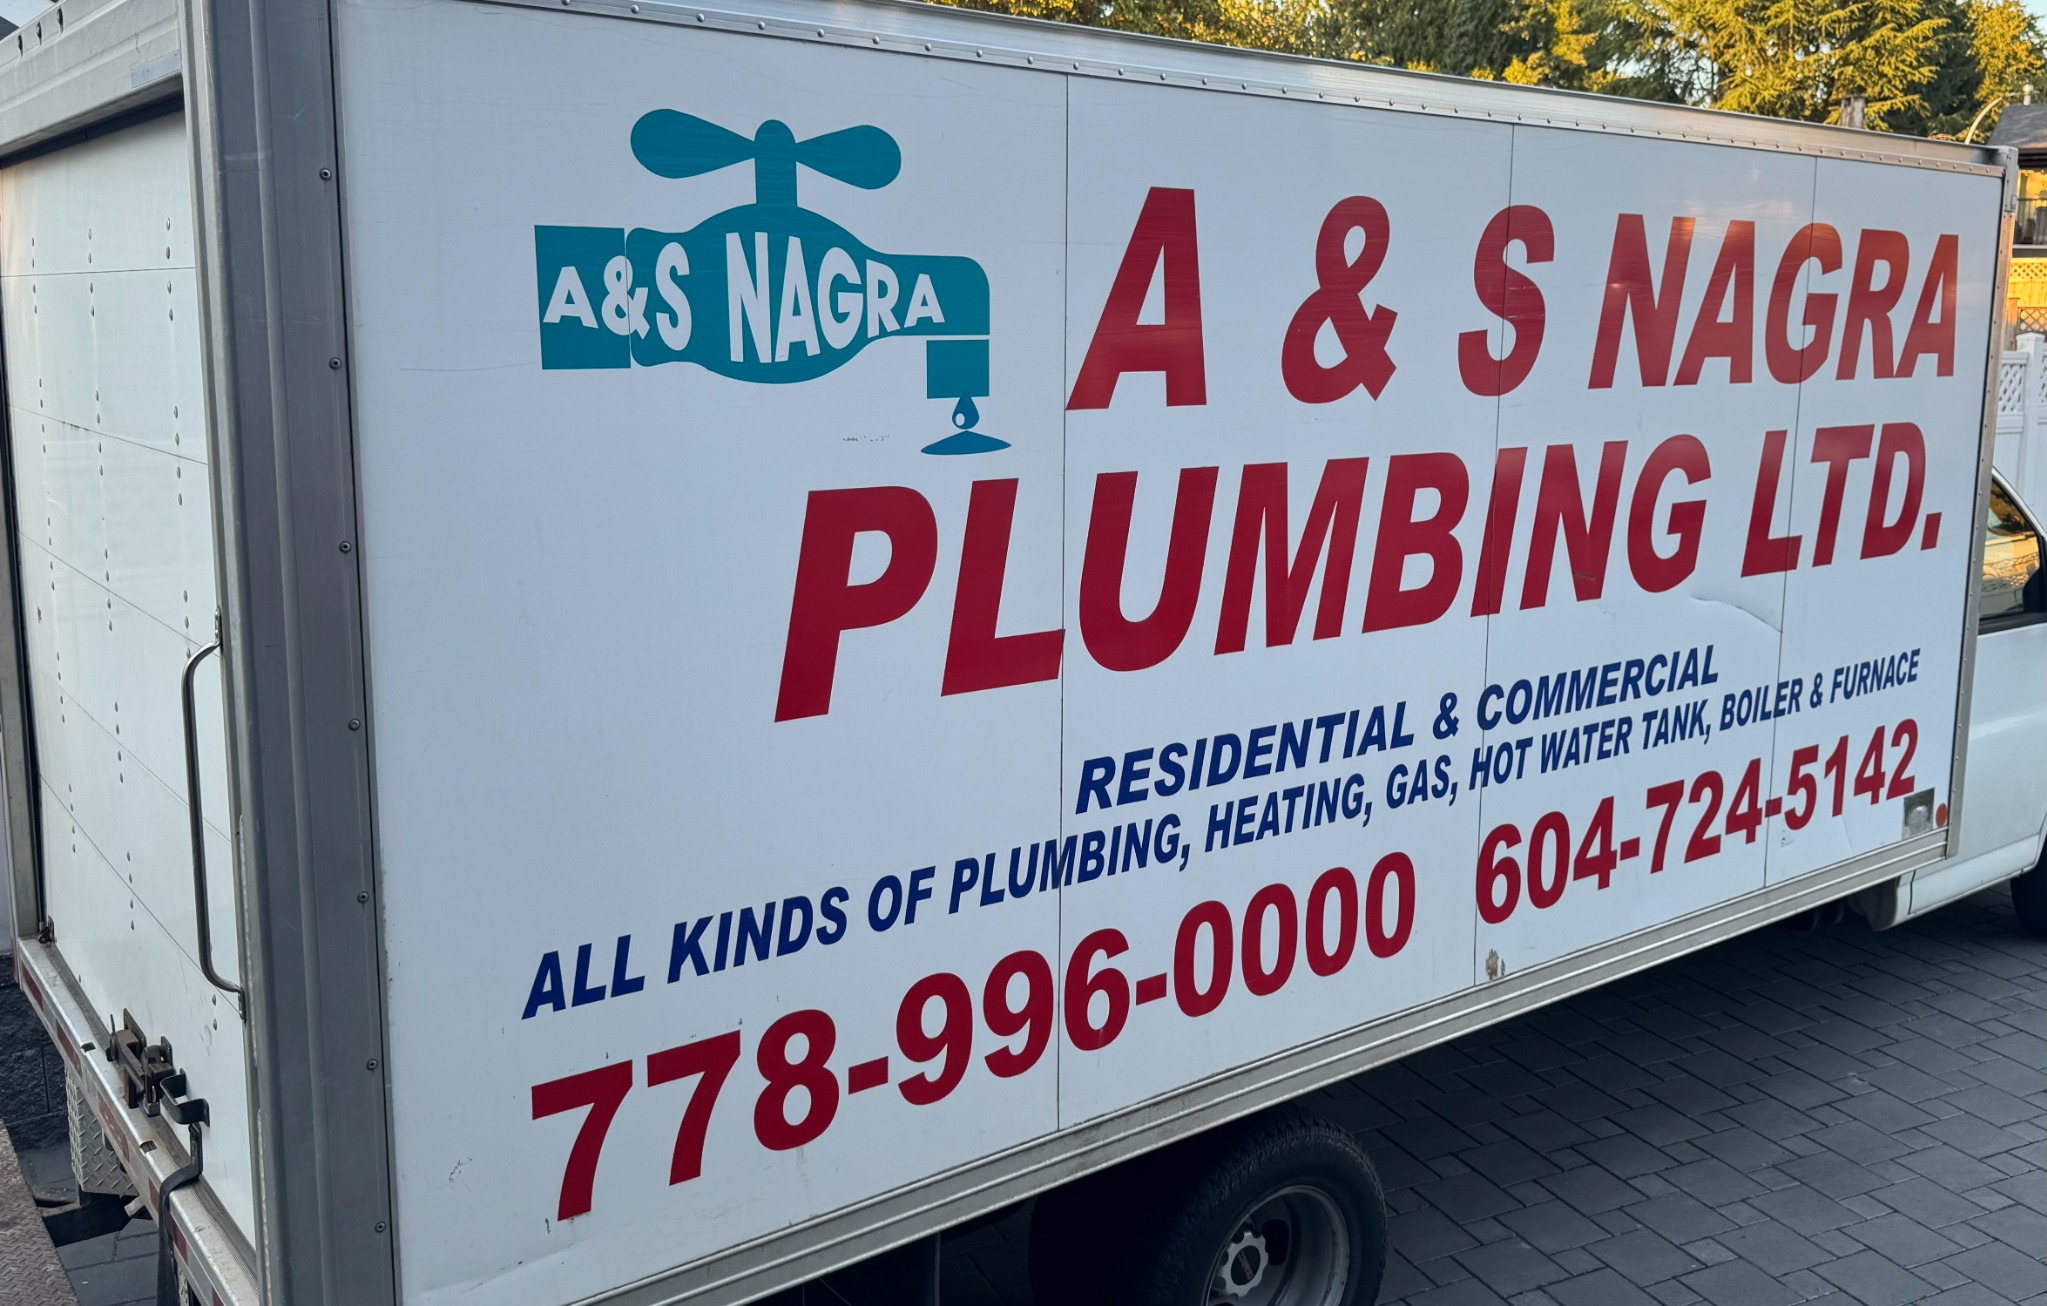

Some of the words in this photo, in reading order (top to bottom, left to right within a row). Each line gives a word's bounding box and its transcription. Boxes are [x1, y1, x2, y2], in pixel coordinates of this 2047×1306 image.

[543, 242, 692, 351] A&S
[726, 231, 945, 364] NAGRA
[1067, 188, 1206, 410] A
[1282, 197, 1397, 403] &
[1458, 205, 1554, 396] S
[1590, 214, 1959, 388] NAGRA
[775, 436, 1710, 722] PLUMBING
[1742, 422, 1941, 577] LTD.
[521, 934, 646, 1020] ALL
[667, 886, 850, 984] KINDS
[867, 865, 936, 933] OF
[948, 813, 1191, 915] PLUMBING,
[1204, 773, 1373, 853] HEATING,
[1386, 754, 1458, 809] GAS,
[1468, 736, 1534, 791] HOT
[1540, 716, 1633, 774] WATER
[1642, 699, 1712, 750] TANK,
[1719, 677, 1804, 731] BOILER
[1809, 671, 1824, 709] &
[1830, 648, 1921, 704] FURNACE
[1075, 700, 1415, 815] RESIDENTIAL
[1432, 692, 1460, 740] &
[1476, 644, 1719, 732] COMMERCIAL
[533, 853, 1416, 1219] 778-996-0000
[1476, 720, 1918, 924] 604-724-5142
